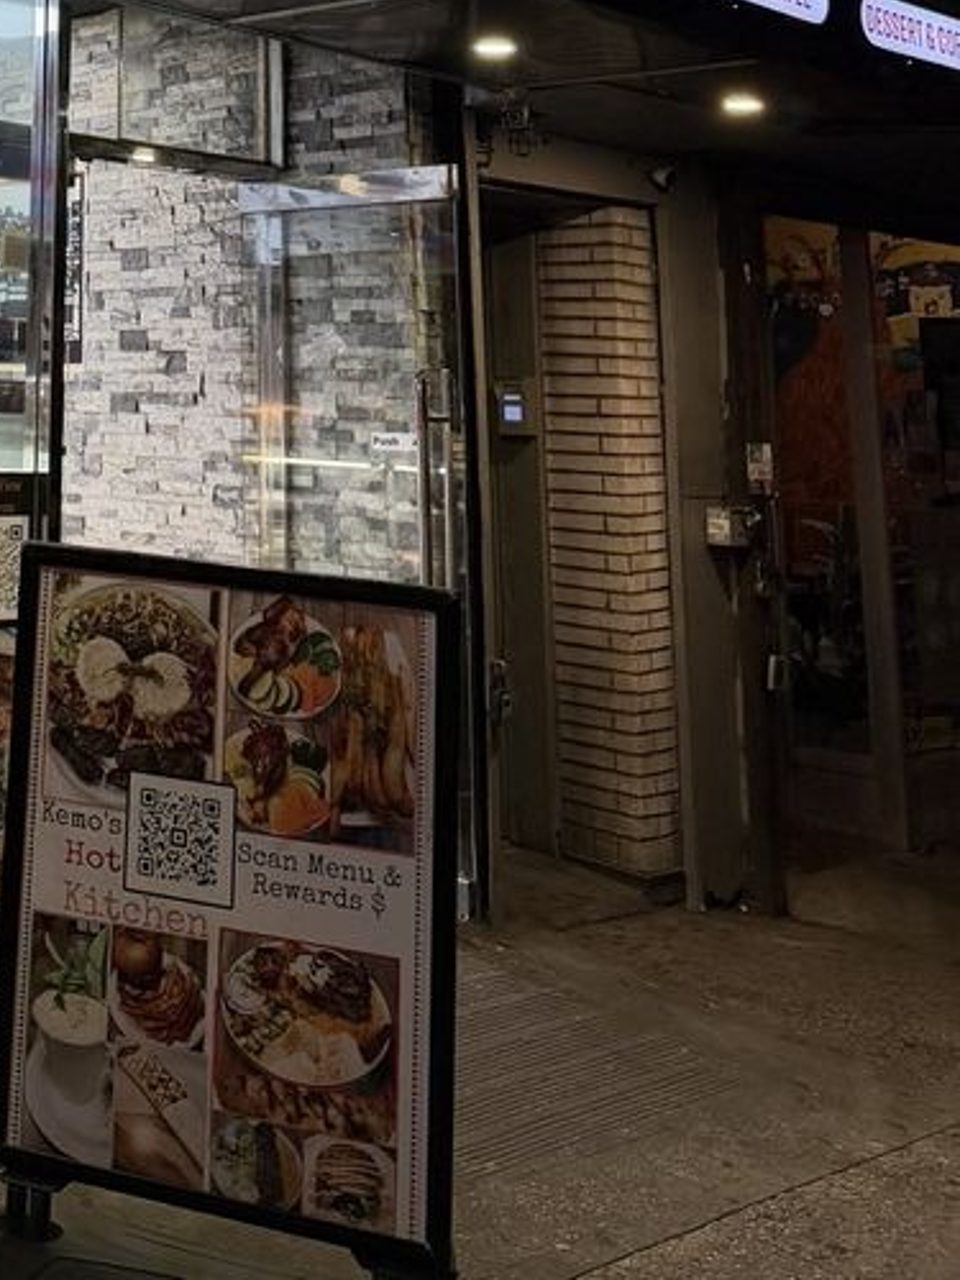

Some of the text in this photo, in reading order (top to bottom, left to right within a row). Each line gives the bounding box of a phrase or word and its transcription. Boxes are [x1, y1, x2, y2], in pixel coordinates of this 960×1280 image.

[865, 4, 923, 48] DESSERT
[926, 23, 936, 50] &
[41, 798, 123, 836] Kemo's
[63, 837, 123, 874] Hot
[238, 842, 403, 889] Scan Menu &
[62, 879, 210, 938] Kitchen
[251, 872, 387, 920] Rewards $
